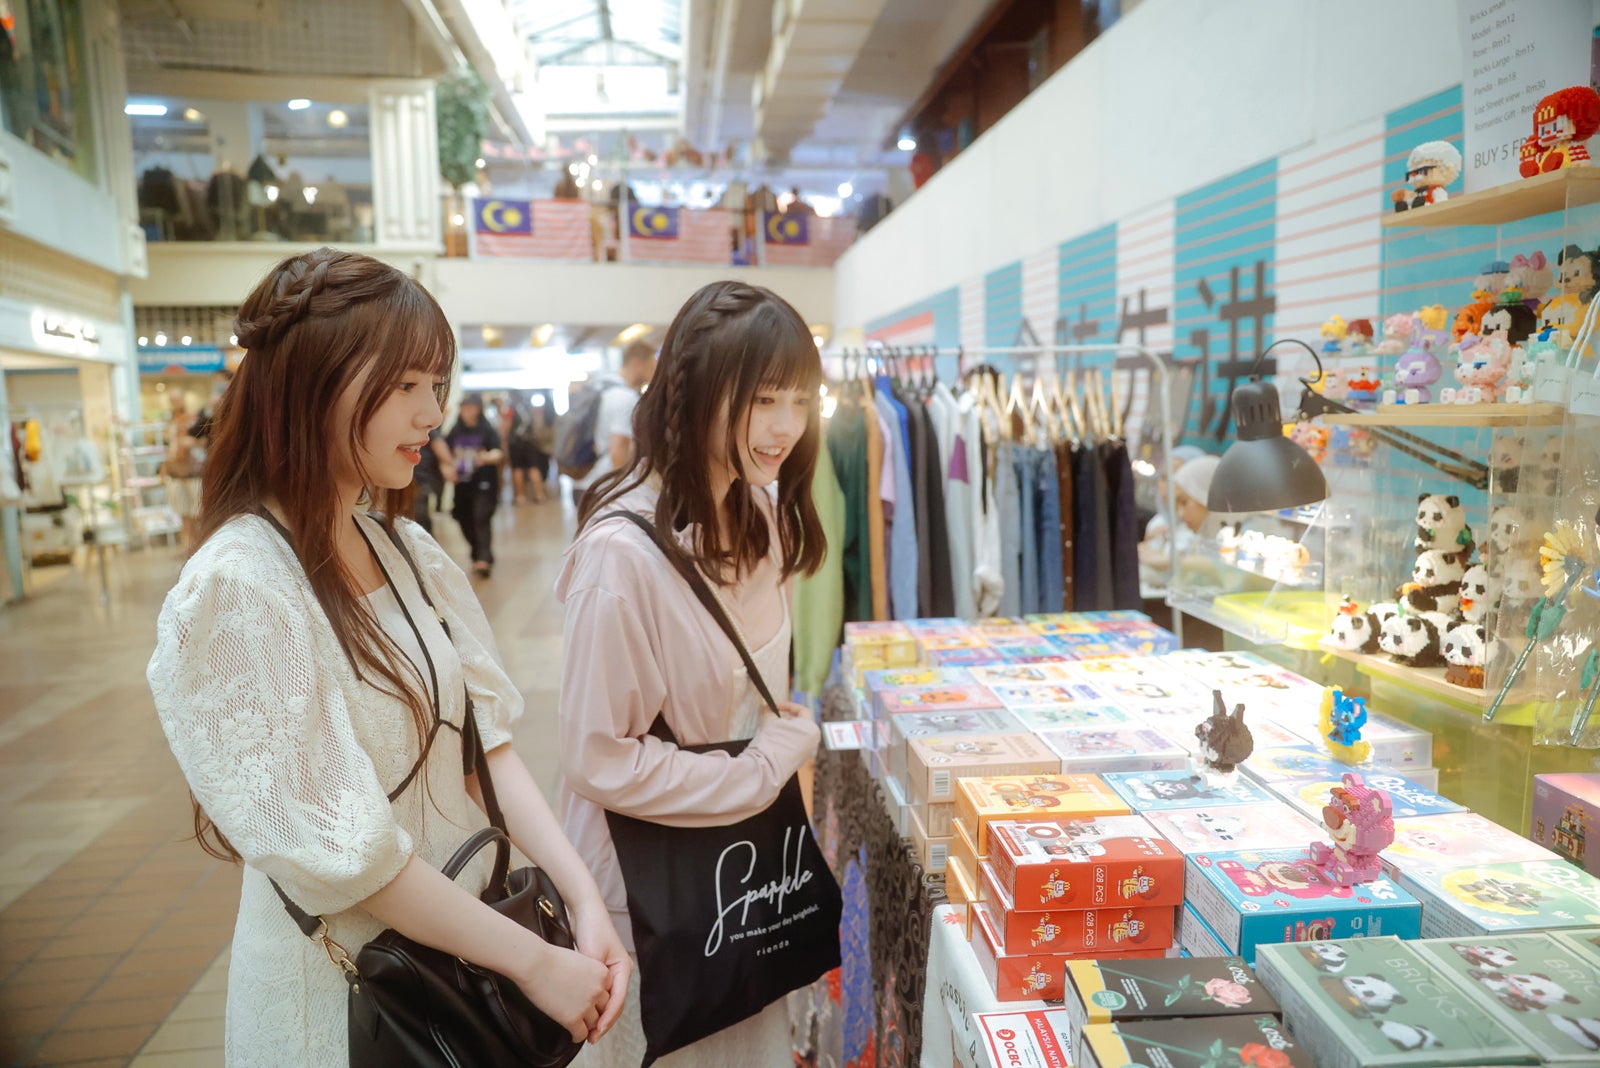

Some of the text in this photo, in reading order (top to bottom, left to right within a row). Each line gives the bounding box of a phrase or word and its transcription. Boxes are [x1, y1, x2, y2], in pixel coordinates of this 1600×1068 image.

[1474, 84, 1493, 96] Panda
[1474, 147, 1499, 169] BUY
[1501, 144, 1509, 160] 5
[704, 824, 814, 957] Sparkle
[1095, 867, 1105, 903] 628 PCS
[729, 932, 745, 943] you
[746, 926, 767, 937] make
[767, 922, 782, 934] your
[781, 917, 793, 927] day
[1085, 911, 1095, 948] 628 PCS
[1385, 957, 1469, 1018] BRICKS
[1034, 1017, 1051, 1049] MALAYSIA
[1003, 1041, 1022, 1067] OCBC
